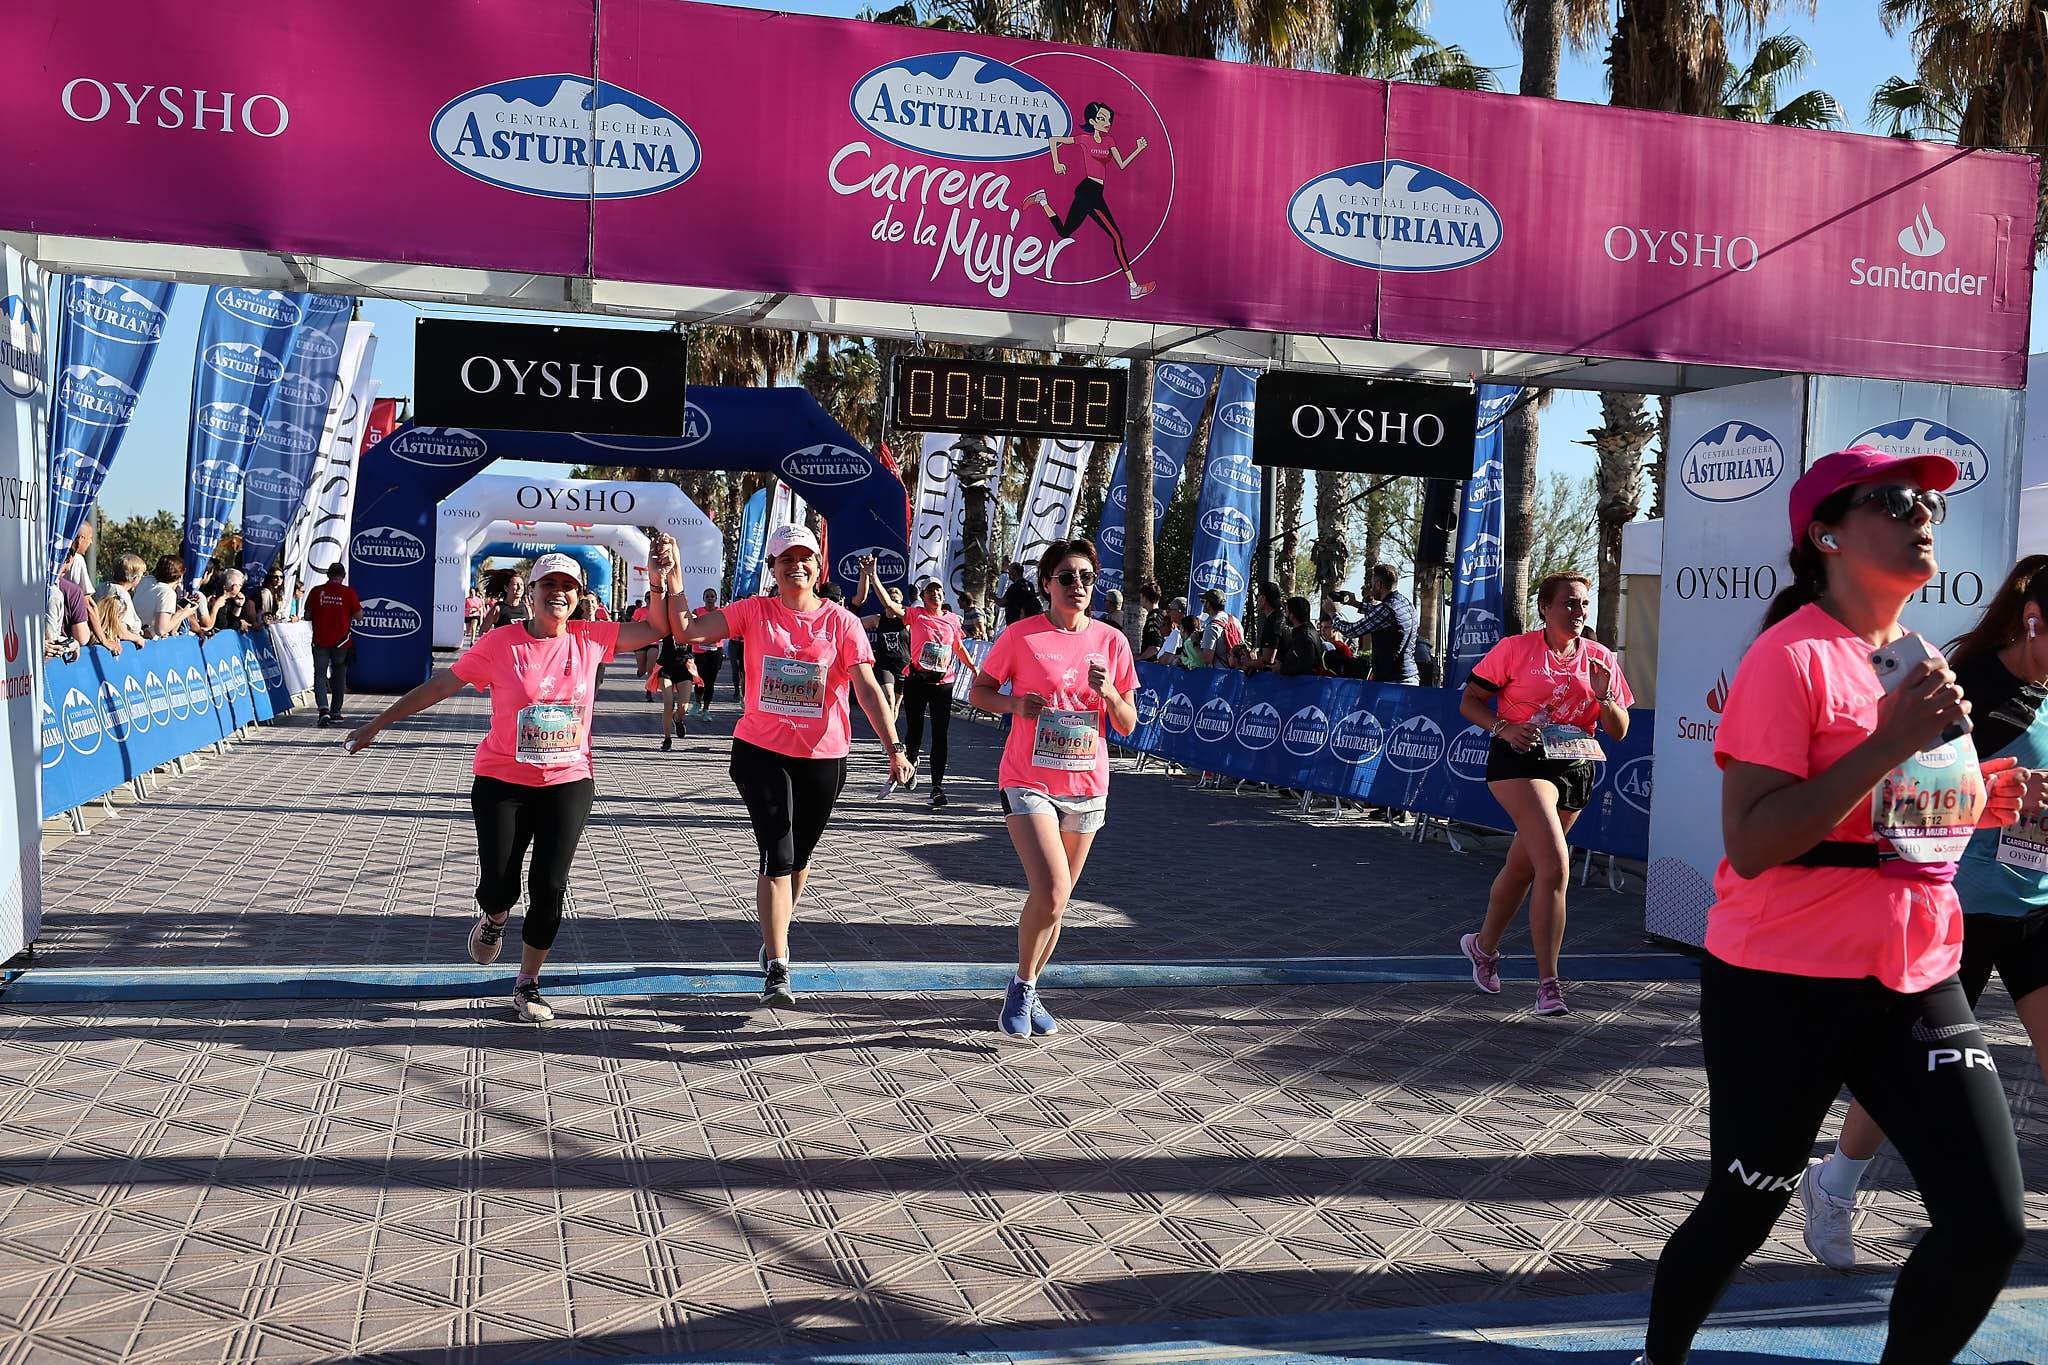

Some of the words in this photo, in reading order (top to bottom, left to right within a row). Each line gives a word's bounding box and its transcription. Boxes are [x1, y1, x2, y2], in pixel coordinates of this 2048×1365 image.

[61, 77, 290, 138] OYSHO
[904, 82, 973, 101] CENTRAL
[980, 91, 1049, 109] LECHERA
[495, 111, 580, 130] CENTRAL
[867, 82, 1052, 140] ASTURIANA
[451, 111, 681, 173] ASTURIANA
[827, 141, 1011, 211] Carrera
[1339, 193, 1406, 209] CENTRAL
[1413, 201, 1480, 216] LECHERA
[871, 204, 905, 243] de
[912, 205, 938, 247] la
[1303, 193, 1486, 249] ASTURIANA
[930, 207, 1076, 298] Mujer
[1603, 225, 1760, 273] OYSHO
[1849, 257, 1989, 297] Santander
[221, 290, 296, 324] ASTURIANA
[0, 339, 39, 379] STURIANA
[460, 355, 649, 403] OYSHO
[909, 369, 1111, 428] 00:42:02
[1152, 412, 1189, 436] STURIANA
[1291, 403, 1446, 448] OYSHO
[261, 432, 312, 451] STURIANA
[396, 437, 480, 458] ASTURIANA
[1926, 447, 1974, 458] LECHERA
[789, 459, 867, 476] ASTURIANA
[1686, 455, 1775, 485] ASTURIANA
[0, 475, 40, 523] YSHO
[516, 485, 636, 514] OYSHO
[443, 508, 481, 519] OYSHO
[667, 517, 703, 526] OYSHO
[354, 541, 420, 559] ASTURIANA
[684, 566, 717, 575] OYSHO
[1676, 564, 1777, 601] OYSHO
[0, 669, 33, 701] ntander
[1237, 718, 1278, 740] ASTURIANA
[1284, 721, 1325, 745] ASTURIANA
[1332, 727, 1379, 753] ASTURIANA
[1388, 734, 1439, 760] ASTURIANA
[1449, 740, 1490, 766] ASTURI
[2006, 837, 2033, 850] CARRERA
[2009, 850, 2042, 864] OYSHO
